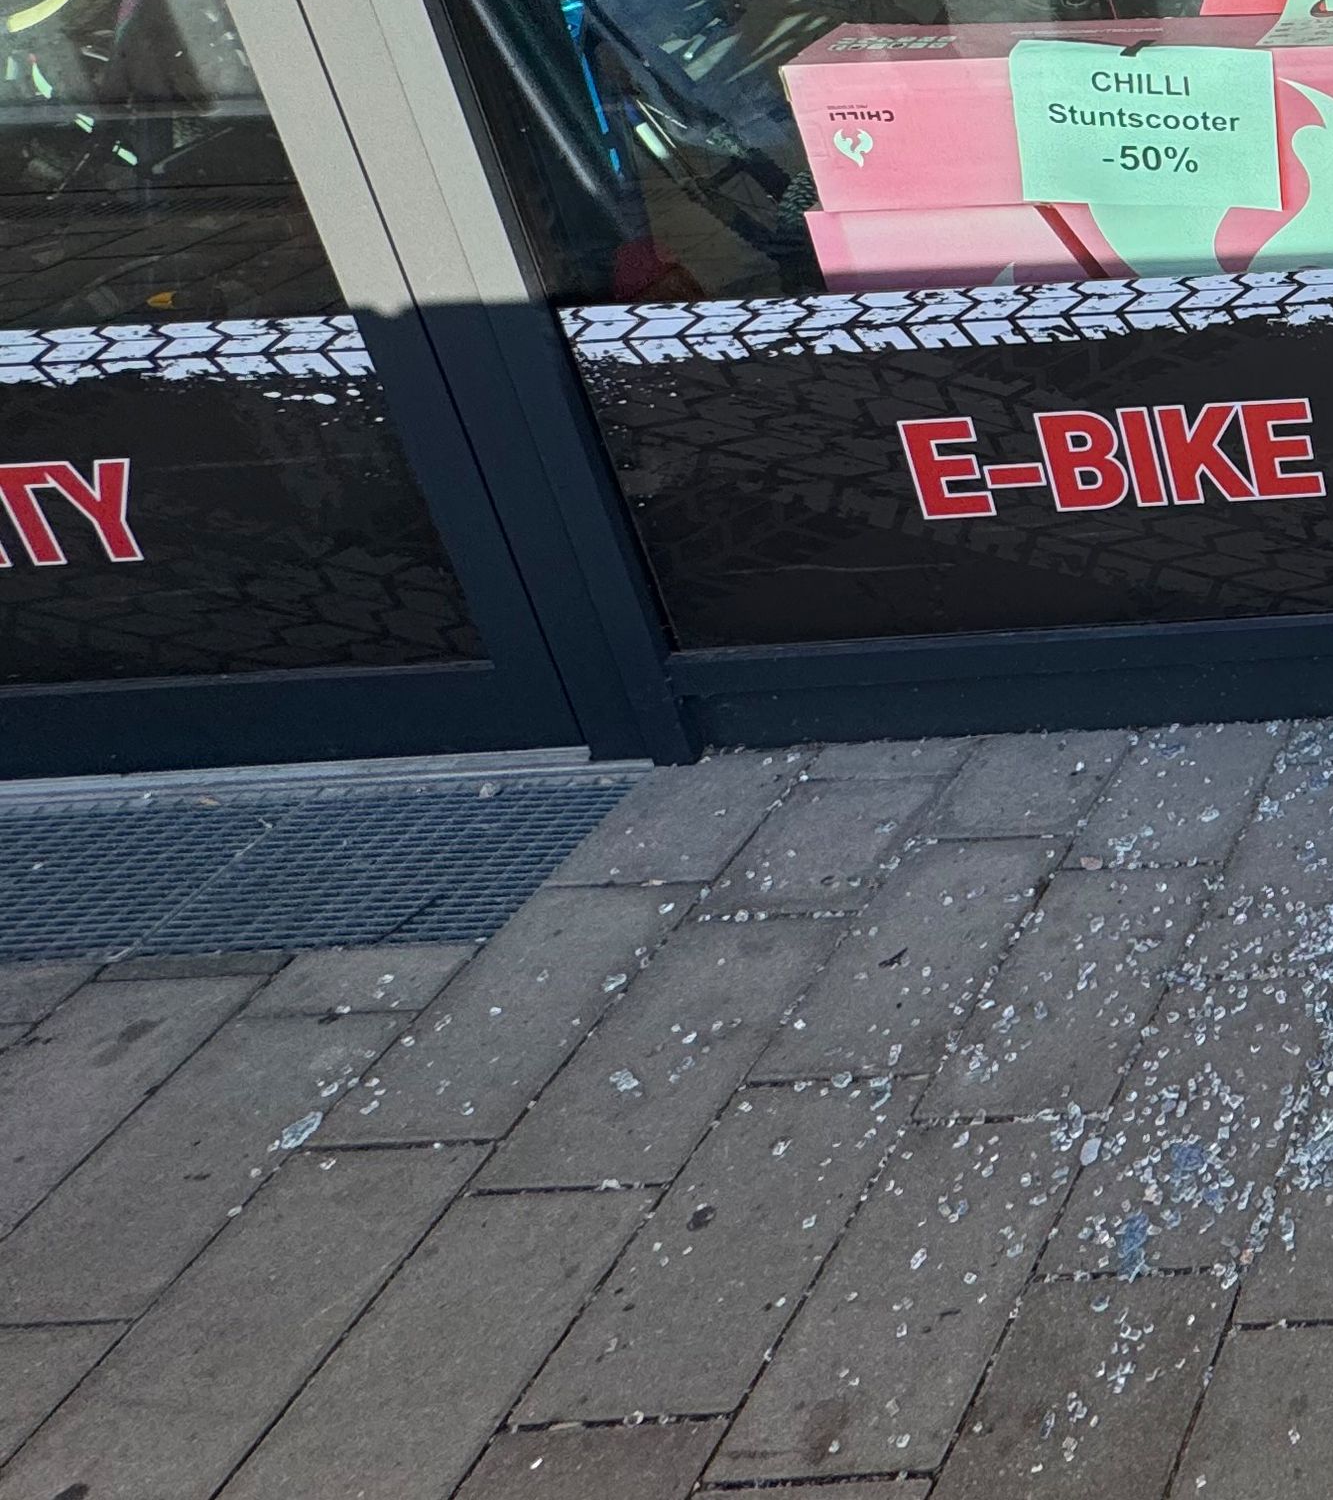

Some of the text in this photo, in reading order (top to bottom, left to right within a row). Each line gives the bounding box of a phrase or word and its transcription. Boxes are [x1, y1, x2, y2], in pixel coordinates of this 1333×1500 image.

[1091, 70, 1192, 97] CHILLI
[828, 111, 895, 122] CHILLI
[1048, 103, 1240, 133] Stuntscooter
[1102, 146, 1199, 174] -50%
[896, 398, 1326, 520] E-BIKE
[0, 457, 144, 568] TY
